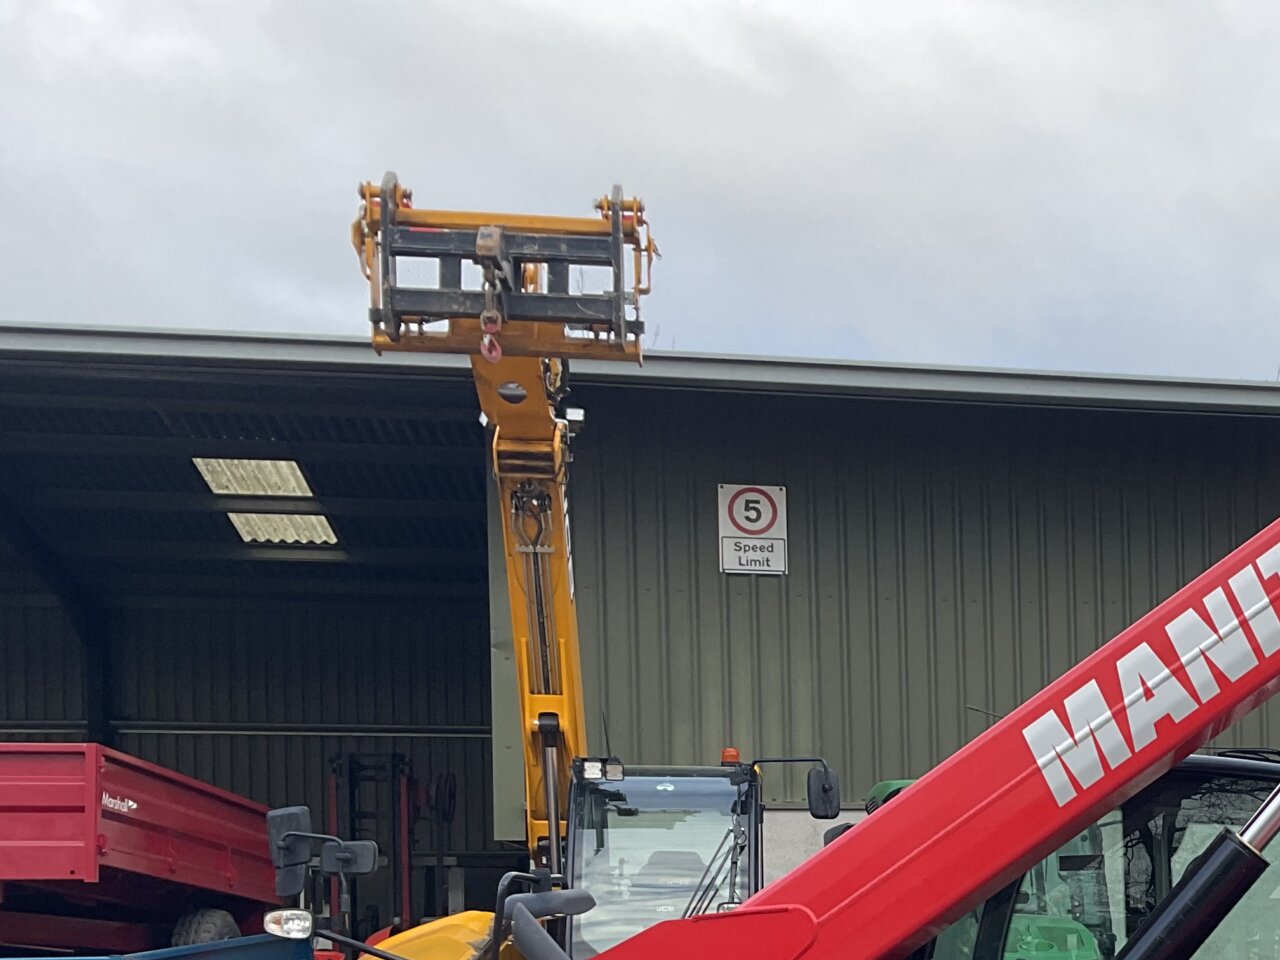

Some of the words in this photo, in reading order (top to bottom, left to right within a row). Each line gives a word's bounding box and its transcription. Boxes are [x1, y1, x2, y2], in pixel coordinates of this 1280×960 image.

[744, 498, 762, 523] 5
[733, 541, 774, 554] Speed
[738, 556, 771, 567] Limit
